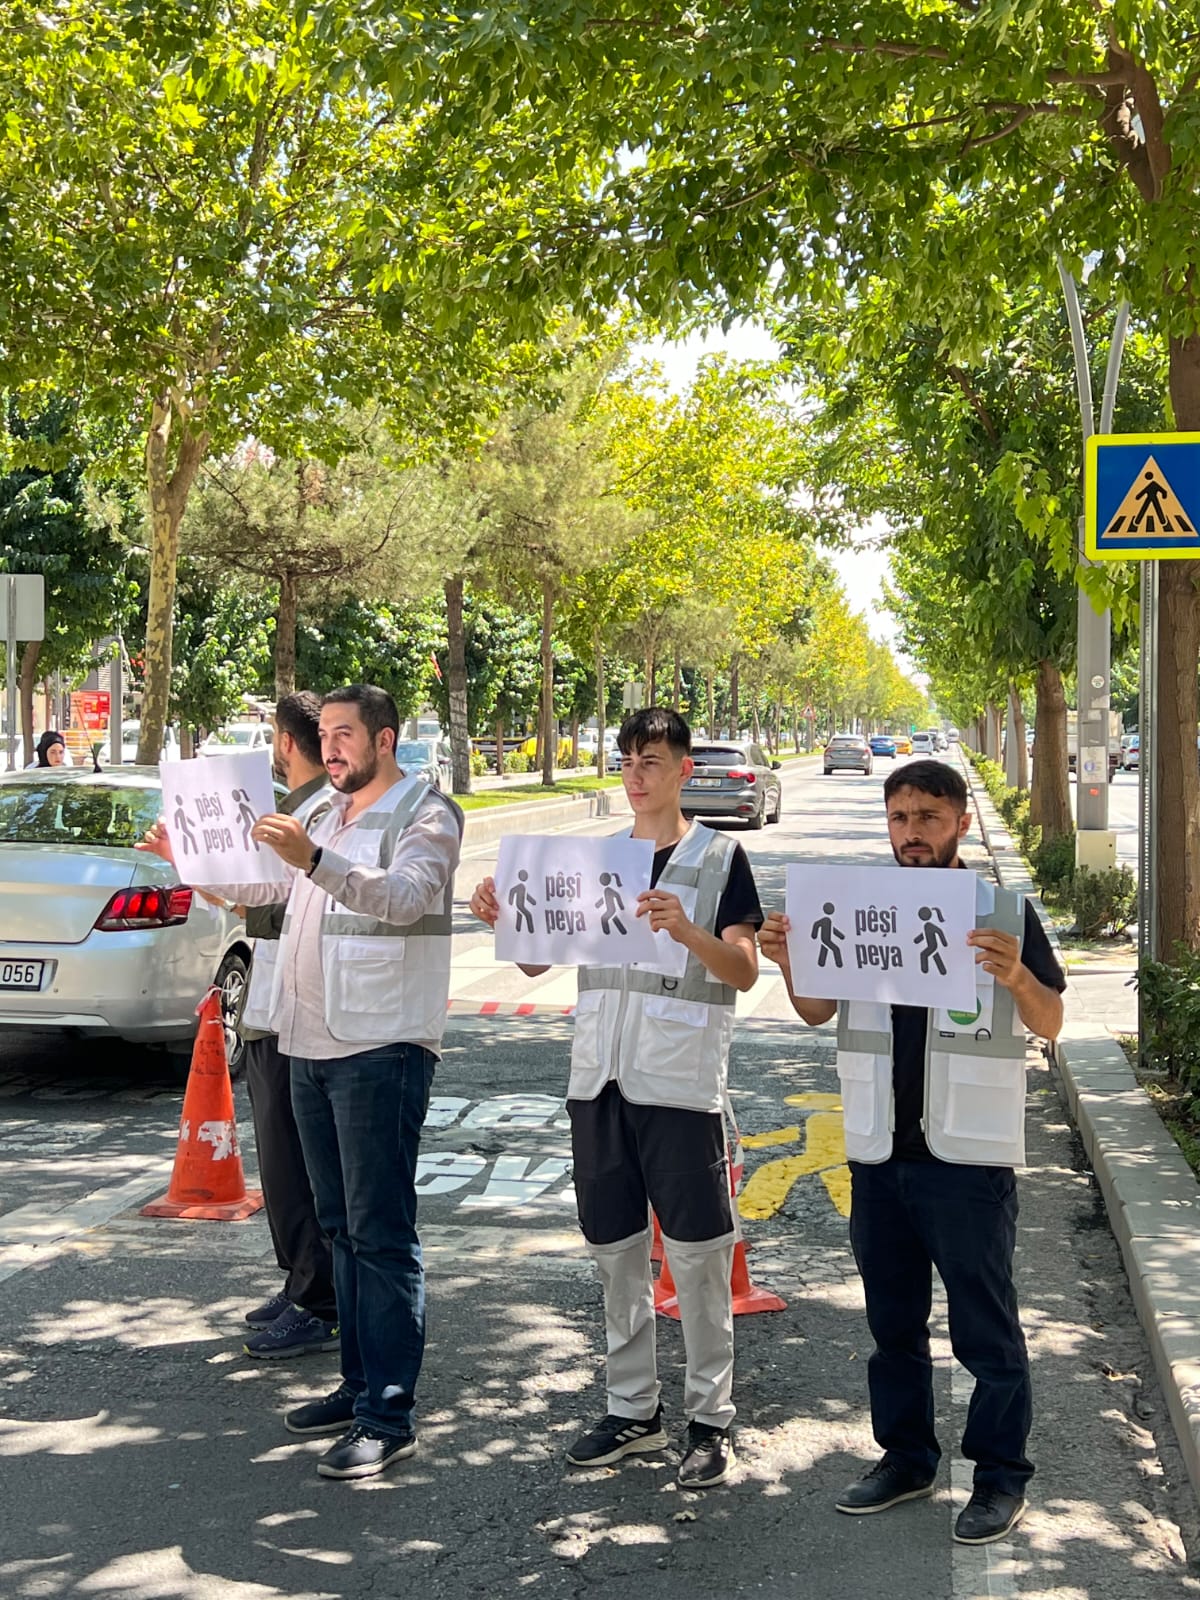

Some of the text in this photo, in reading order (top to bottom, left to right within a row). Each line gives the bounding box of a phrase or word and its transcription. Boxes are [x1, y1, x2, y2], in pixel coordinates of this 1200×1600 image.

[194, 792, 224, 822] pêşî
[202, 827, 234, 854] peya
[545, 871, 582, 902] pêşî
[545, 909, 587, 936] peya
[855, 905, 898, 938] pêşî
[855, 944, 903, 971] peya
[2, 964, 35, 983] 056
